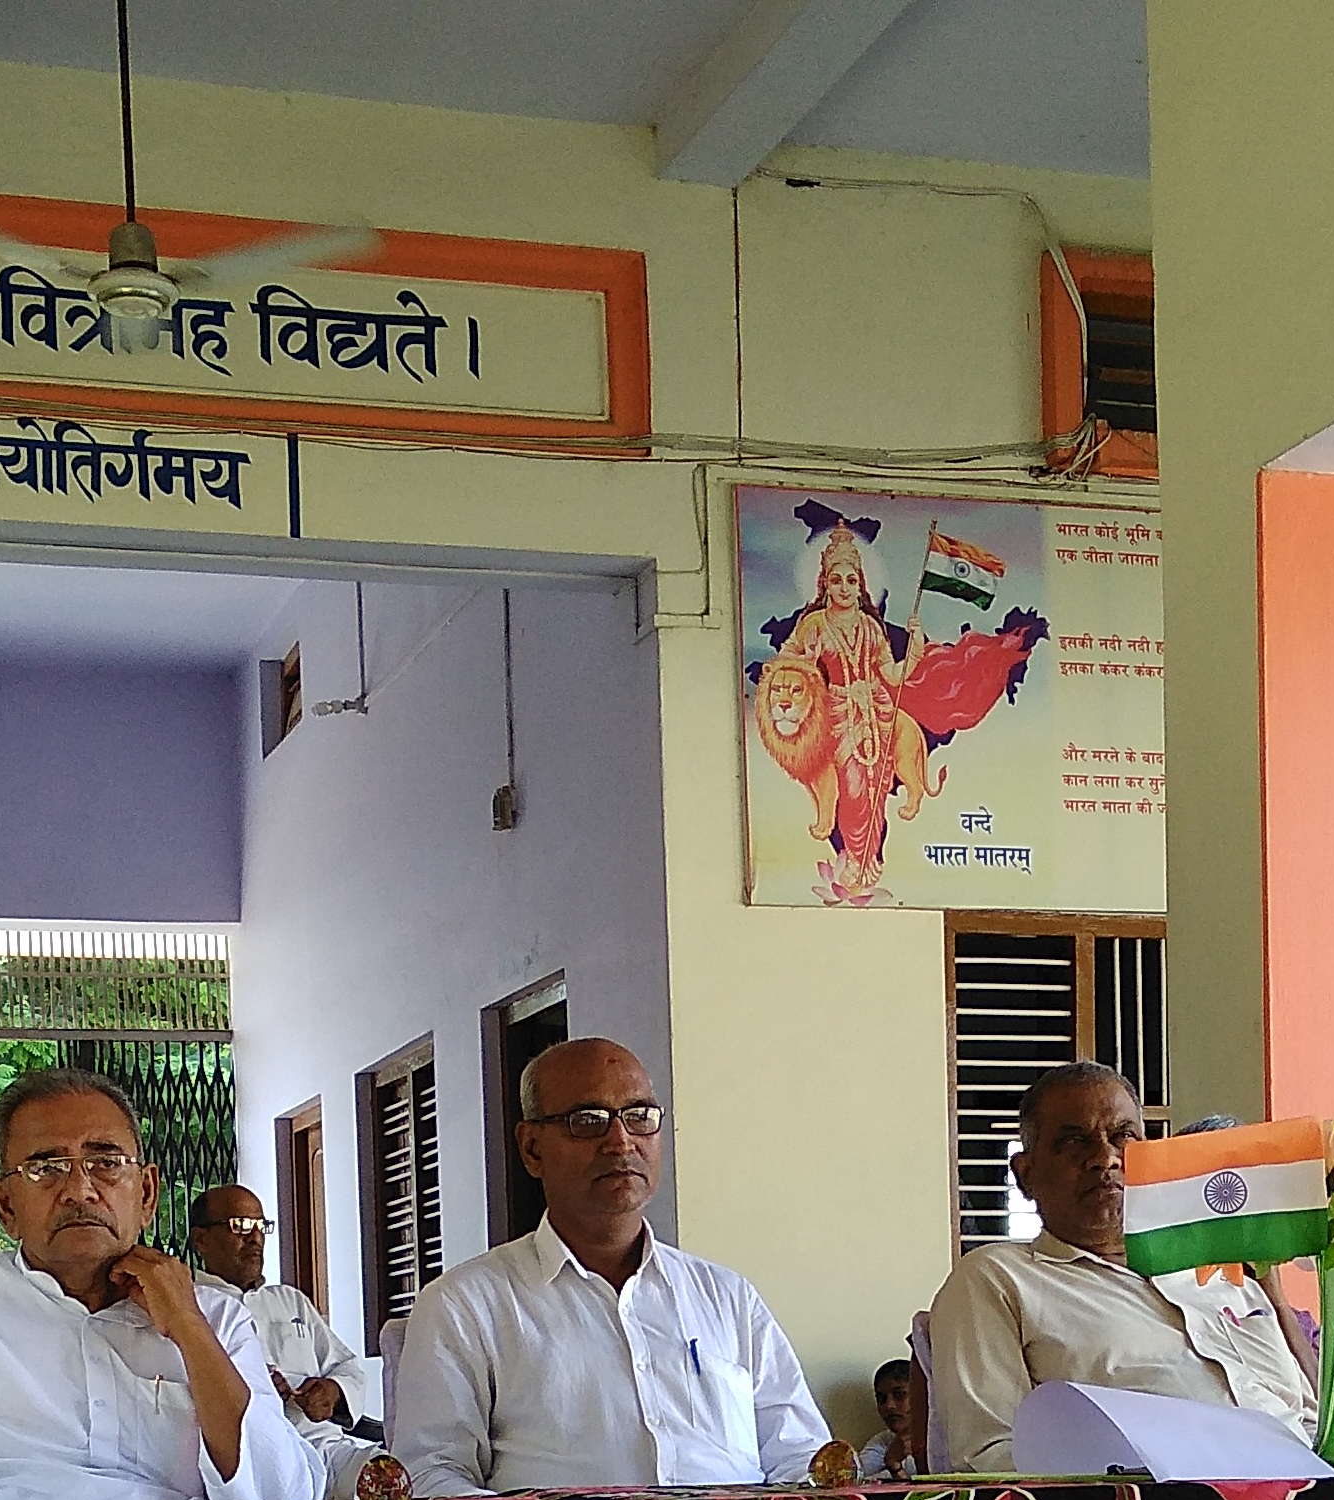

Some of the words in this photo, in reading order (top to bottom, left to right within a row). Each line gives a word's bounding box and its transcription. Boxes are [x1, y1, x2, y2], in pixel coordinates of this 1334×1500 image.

[1056, 523, 1089, 537] भारत
[1094, 521, 1119, 541] कोई
[1125, 524, 1151, 545] भूमि
[1056, 549, 1077, 564] एक
[1082, 546, 1113, 564] जीता
[1118, 552, 1159, 567] जागता
[1058, 633, 1093, 651] इसकी
[1098, 634, 1122, 651] नदी
[1127, 636, 1150, 652] नदी
[1059, 661, 1094, 676] इसका
[1099, 660, 1129, 677] कंकर
[1062, 742, 1087, 762] और
[1091, 746, 1120, 762] मरने
[1125, 747, 1136, 763] के
[1062, 774, 1088, 787] कान
[1093, 776, 1120, 788] लगा
[1125, 777, 1144, 789] कर
[1064, 799, 1097, 812] भारत
[1102, 801, 1131, 813] माता
[1136, 798, 1152, 813] की
[960, 806, 992, 835] वन्दे
[924, 845, 968, 866] भारत
[974, 847, 1032, 875] मातरम्
